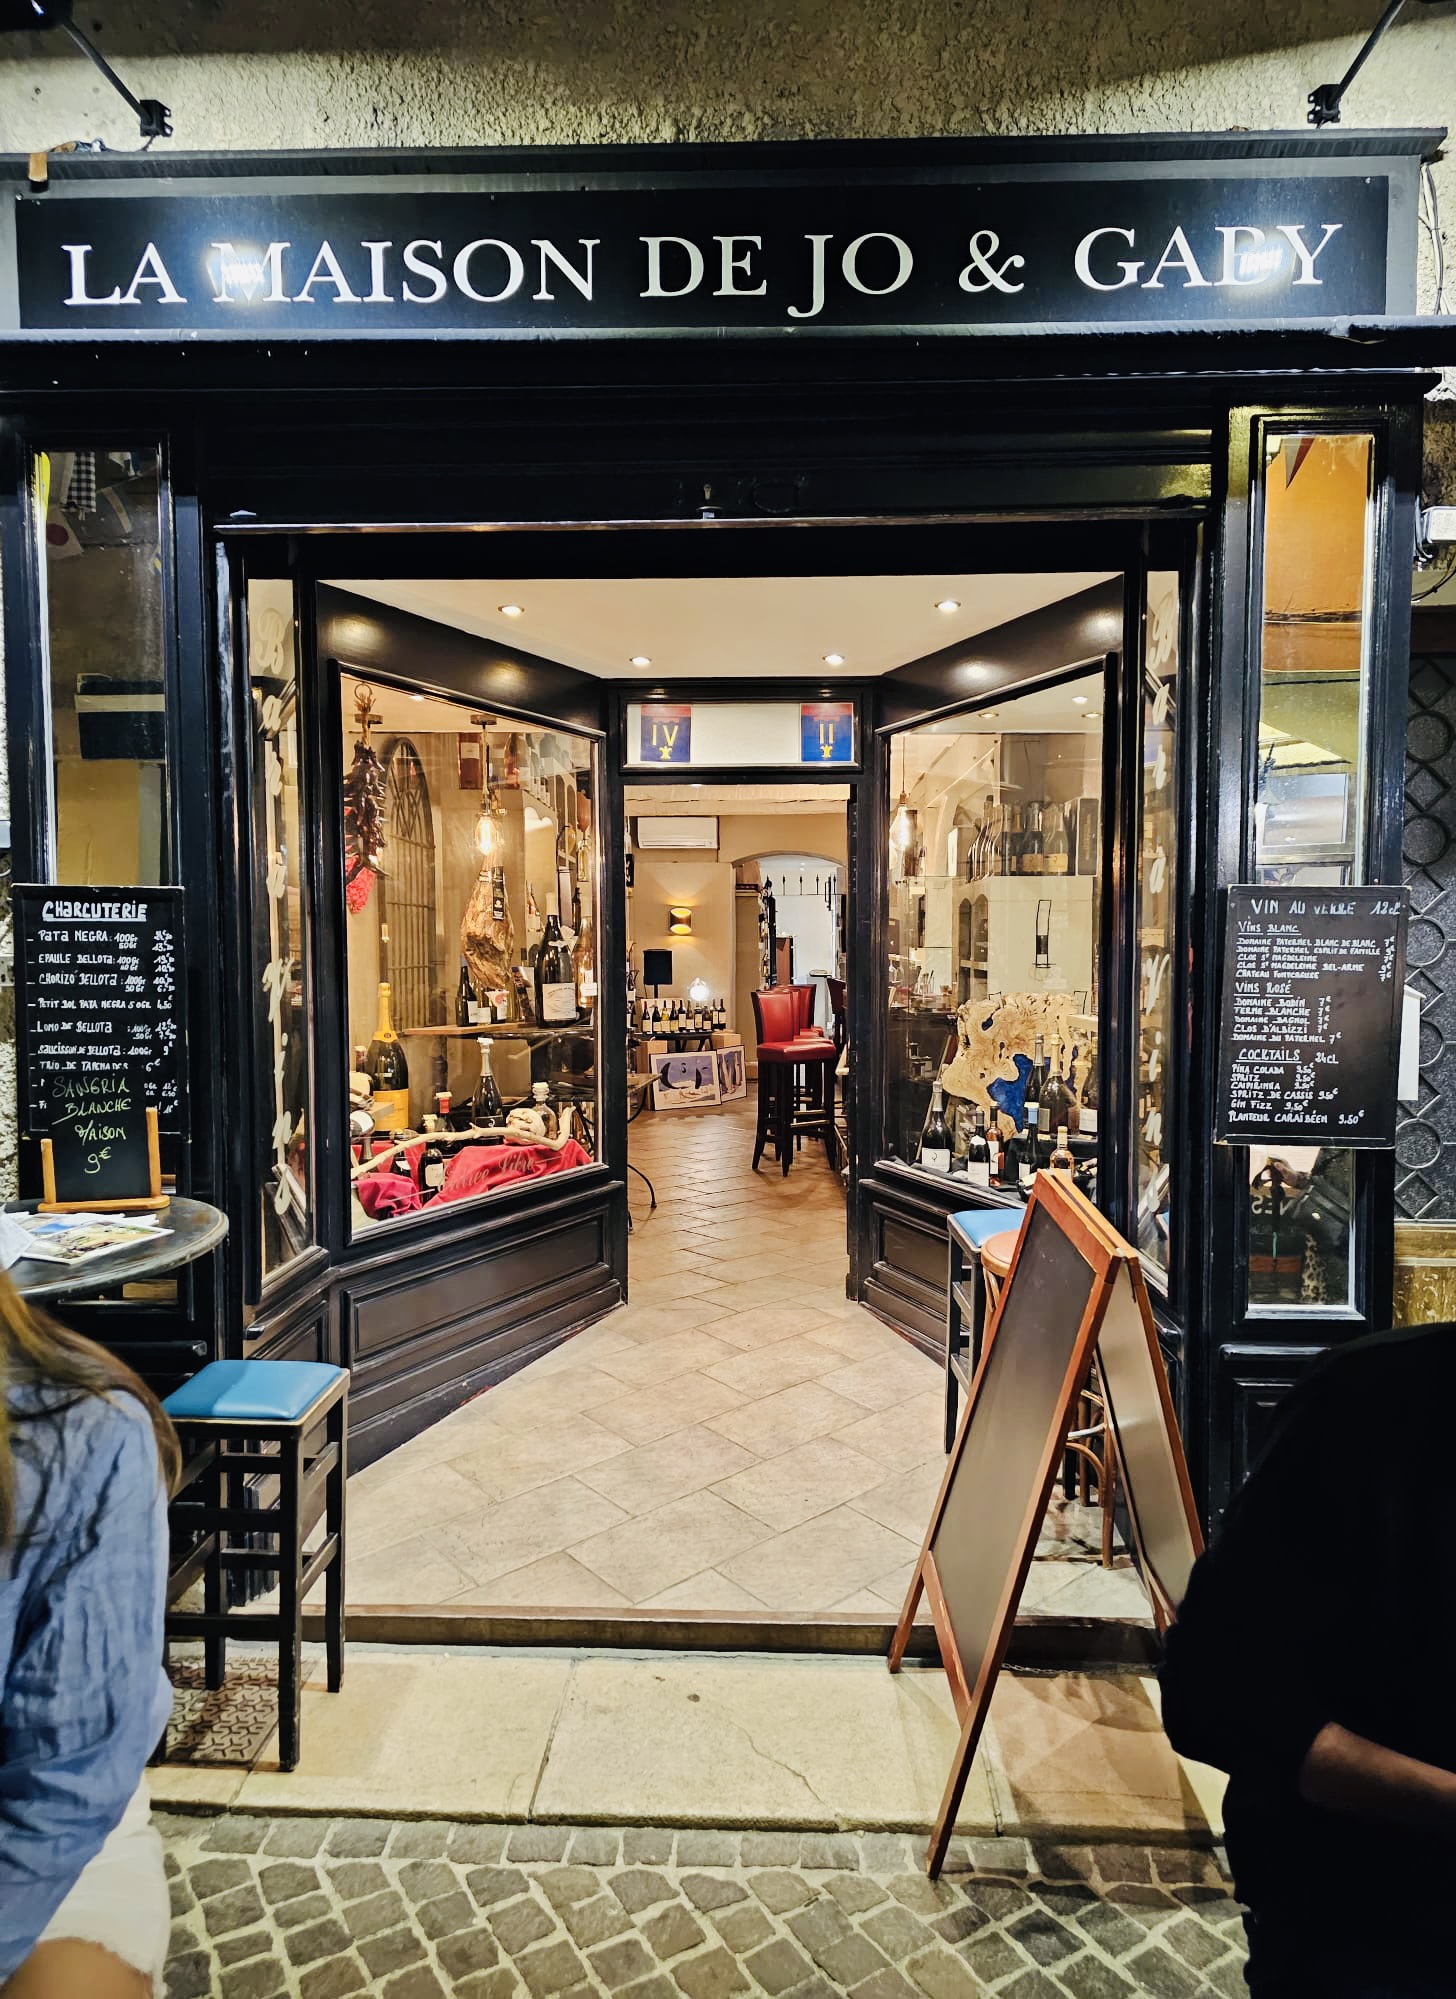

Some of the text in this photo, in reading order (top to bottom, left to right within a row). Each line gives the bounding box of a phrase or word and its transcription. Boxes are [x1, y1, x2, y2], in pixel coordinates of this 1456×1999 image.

[61, 241, 187, 306] LA
[210, 237, 600, 302] MAISON
[638, 234, 767, 298] DE
[788, 232, 914, 318] JO
[958, 230, 1026, 294] &
[652, 724, 678, 747] IV
[819, 723, 834, 745] II
[1251, 898, 1279, 915] VIN
[1289, 901, 1306, 914] AU
[1236, 938, 1272, 946] DOMAINE
[1234, 998, 1272, 1007] DOMAINE
[58, 1098, 131, 1120] BLANCHE
